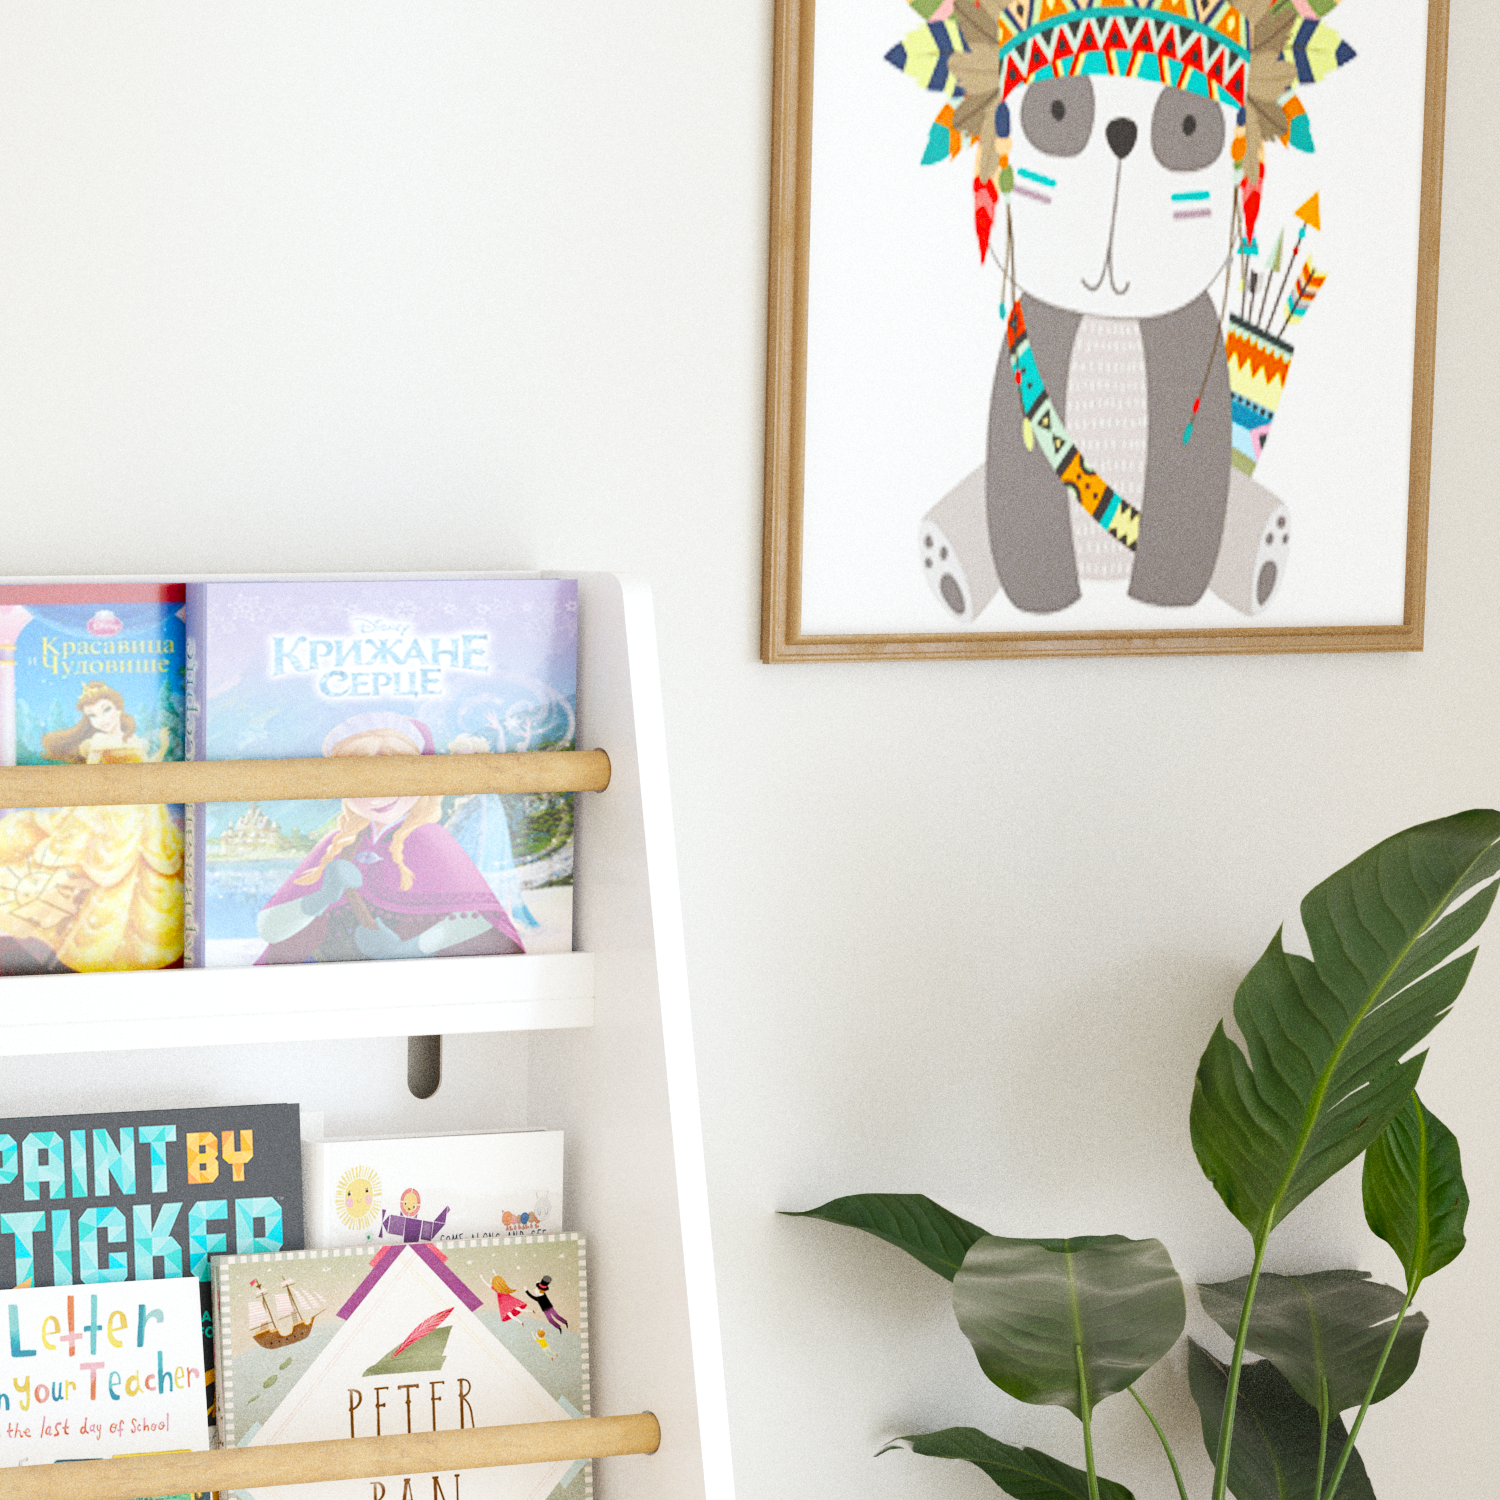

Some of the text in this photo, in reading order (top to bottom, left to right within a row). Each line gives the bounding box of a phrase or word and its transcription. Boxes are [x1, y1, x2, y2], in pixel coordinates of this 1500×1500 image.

[41, 636, 175, 660] Красавица
[272, 634, 489, 677] КРИЖАНЕ
[319, 669, 442, 699] СЕРЦЕ
[185, 1129, 254, 1185] BY
[7, 1294, 164, 1358] Letter
[13, 1376, 77, 1411] your
[79, 1350, 200, 1401] Teacher
[6, 1422, 32, 1439] the
[40, 1415, 70, 1439] last
[80, 1416, 102, 1441] day
[109, 1419, 125, 1438] of
[130, 1412, 170, 1434] School
[347, 1378, 475, 1439] PETER
